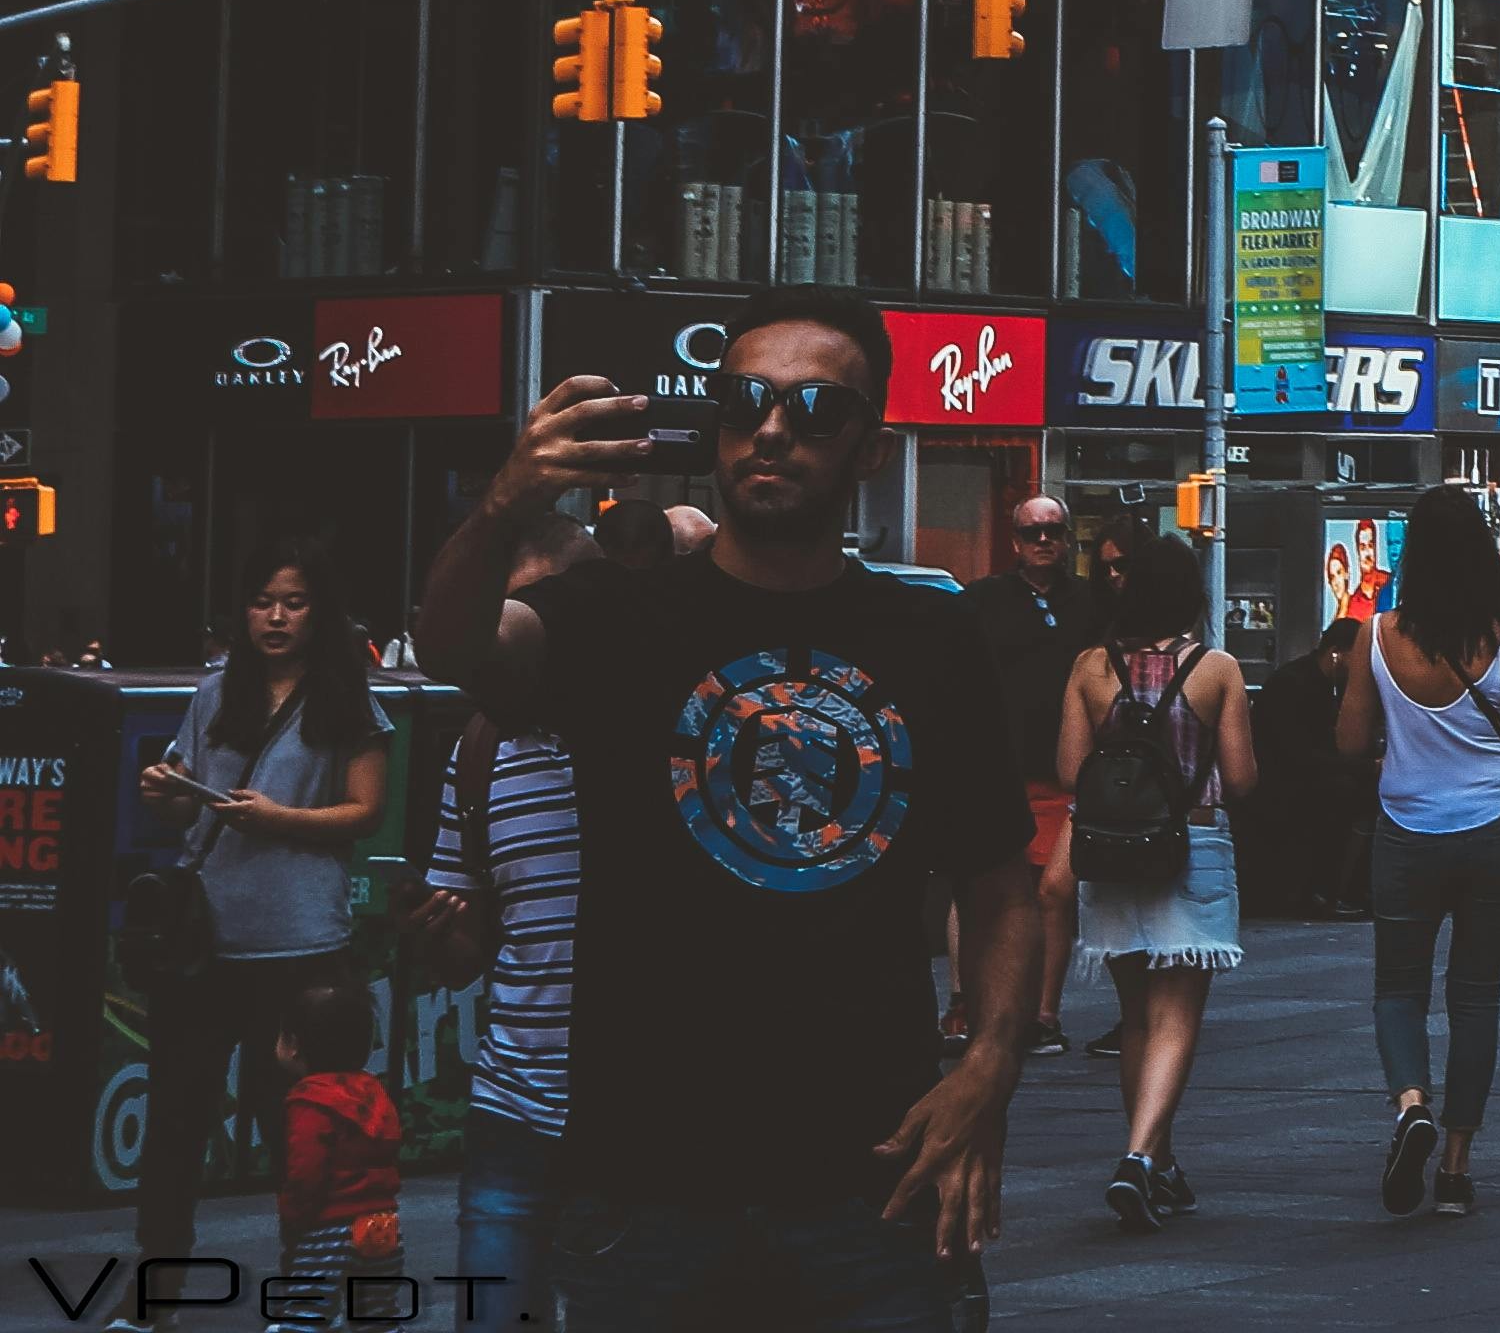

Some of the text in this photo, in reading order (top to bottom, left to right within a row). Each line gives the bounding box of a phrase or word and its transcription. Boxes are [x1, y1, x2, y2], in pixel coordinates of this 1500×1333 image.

[1240, 209, 1322, 230] BROADWAY
[1242, 233, 1319, 251] FLEA MARKET
[320, 325, 402, 390] Ray-Ban
[930, 324, 1012, 415] Ray-Ban
[214, 370, 305, 387] OAKLEY
[655, 373, 709, 397] OAK
[1078, 338, 1427, 414] SKERS
